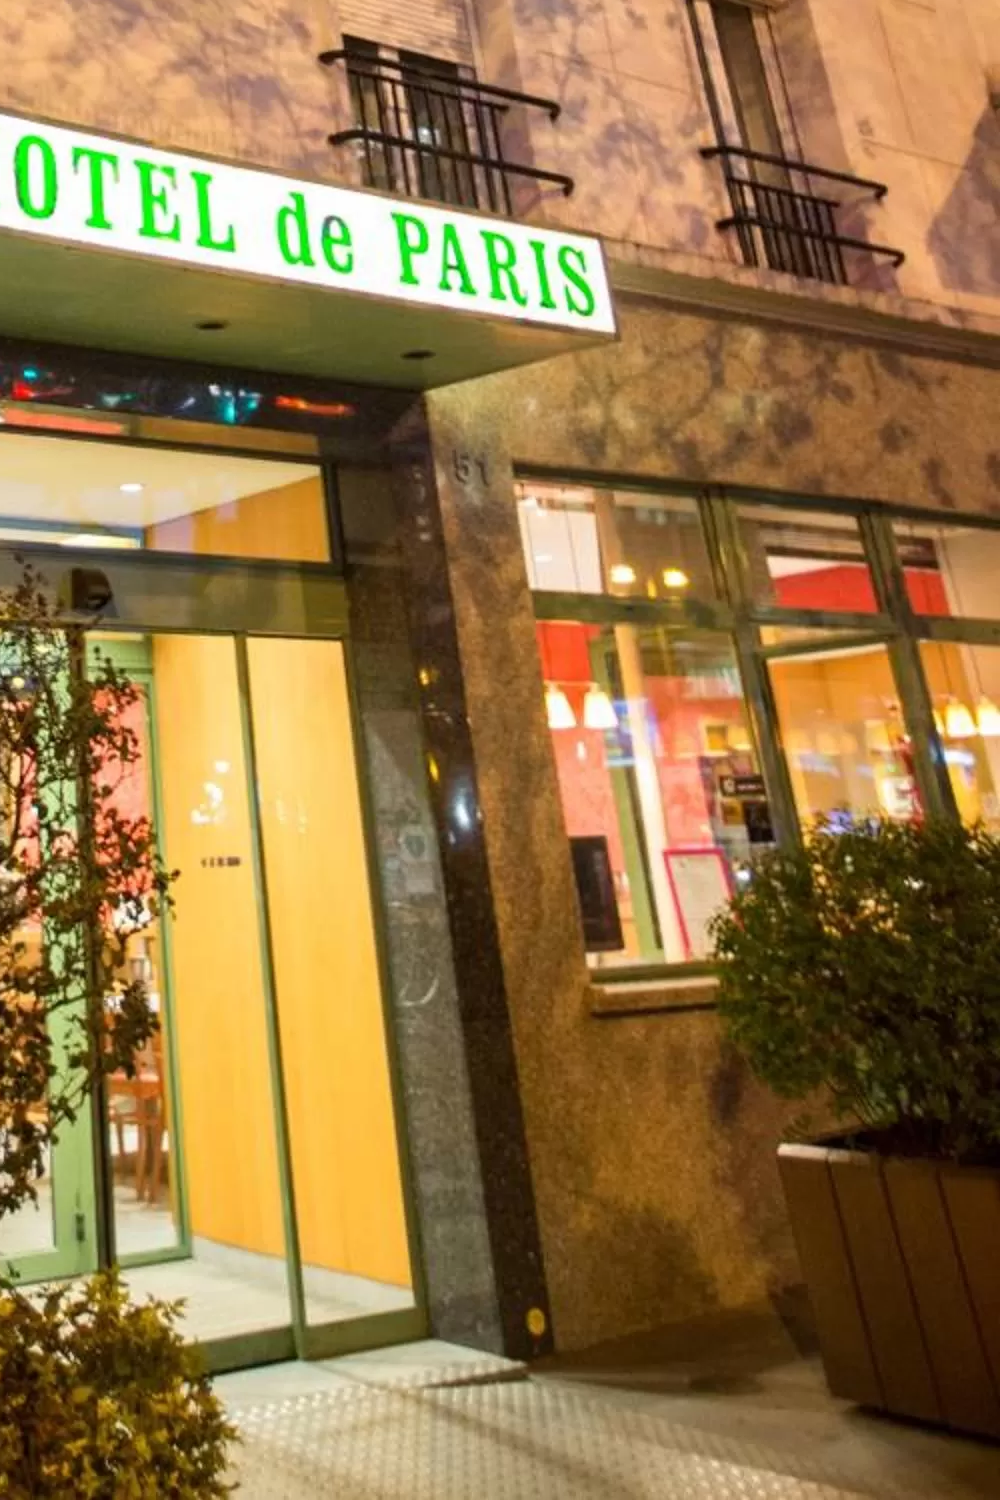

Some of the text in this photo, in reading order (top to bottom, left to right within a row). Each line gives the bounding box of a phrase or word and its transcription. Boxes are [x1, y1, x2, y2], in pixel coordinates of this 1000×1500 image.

[275, 191, 356, 275] de
[391, 211, 597, 317] PARIS
[451, 449, 490, 487] 51
